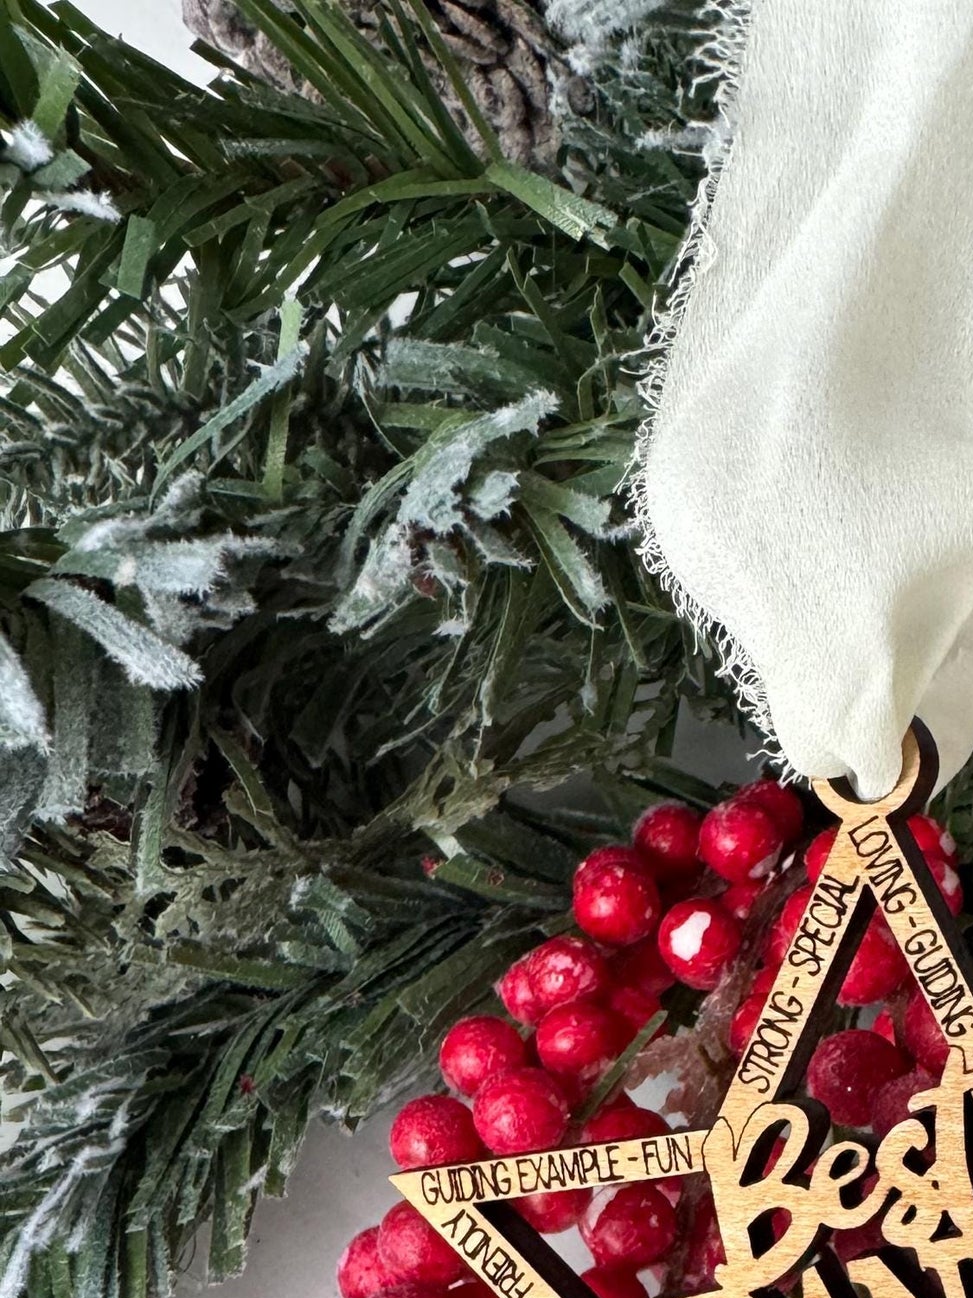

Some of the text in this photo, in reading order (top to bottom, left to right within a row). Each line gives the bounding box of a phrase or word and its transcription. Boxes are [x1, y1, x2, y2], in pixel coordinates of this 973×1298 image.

[848, 816, 916, 914] LOVING
[738, 875, 860, 1093] STRONG SPECIAL
[420, 1136, 694, 1205] GUIDING EXAMPLE FUN
